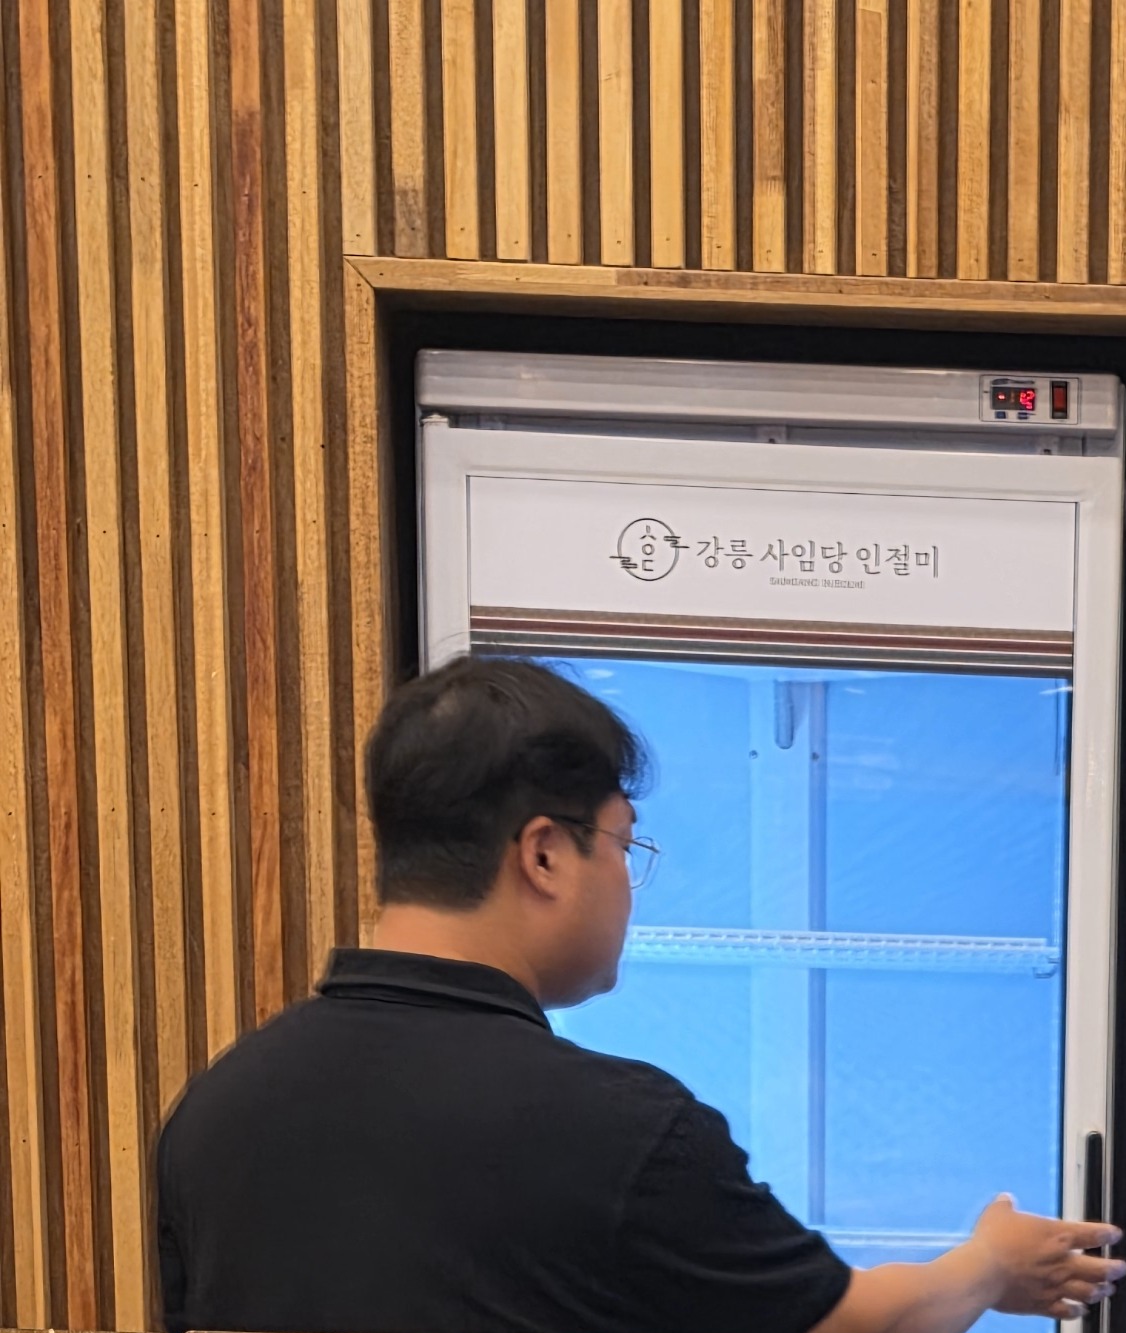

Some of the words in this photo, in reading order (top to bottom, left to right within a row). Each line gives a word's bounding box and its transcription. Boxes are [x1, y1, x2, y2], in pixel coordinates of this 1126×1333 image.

[696, 536, 753, 569] 강릉
[760, 539, 848, 574] 사임당
[855, 544, 939, 578] 인절미
